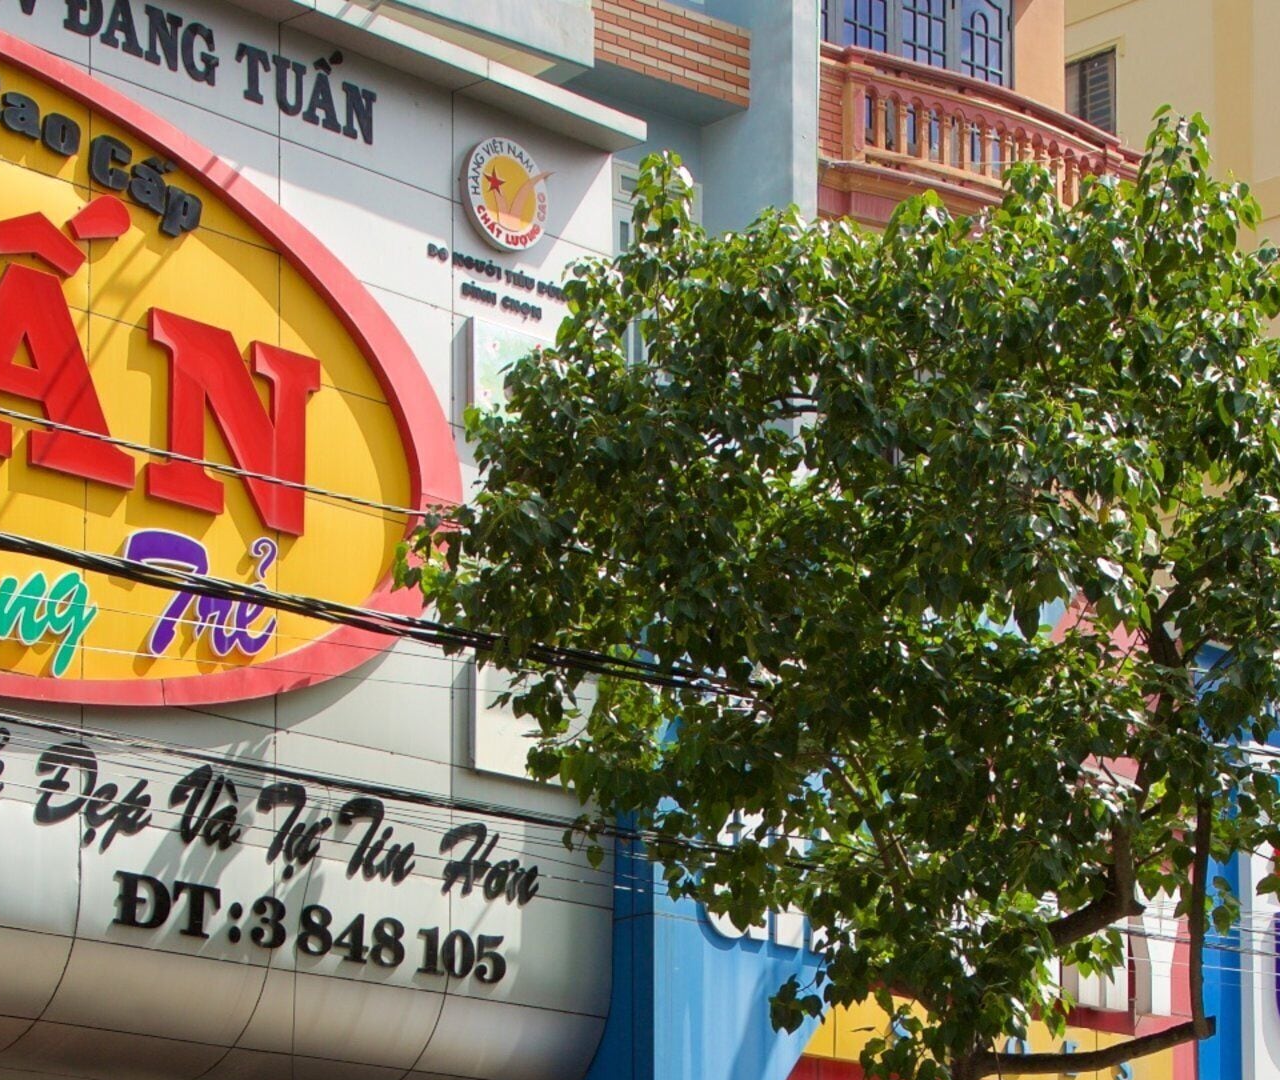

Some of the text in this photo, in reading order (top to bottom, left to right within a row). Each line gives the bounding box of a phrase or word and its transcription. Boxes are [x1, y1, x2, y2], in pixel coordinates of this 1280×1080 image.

[235, 50, 377, 145] TUẤN
[88, 130, 204, 238] Cấp
[507, 141, 536, 174] NAM
[536, 192, 549, 222] CAO
[122, 529, 279, 658] Trẻ
[34, 742, 153, 854] Đẹp
[168, 764, 241, 851] Và
[340, 797, 416, 882] Tin
